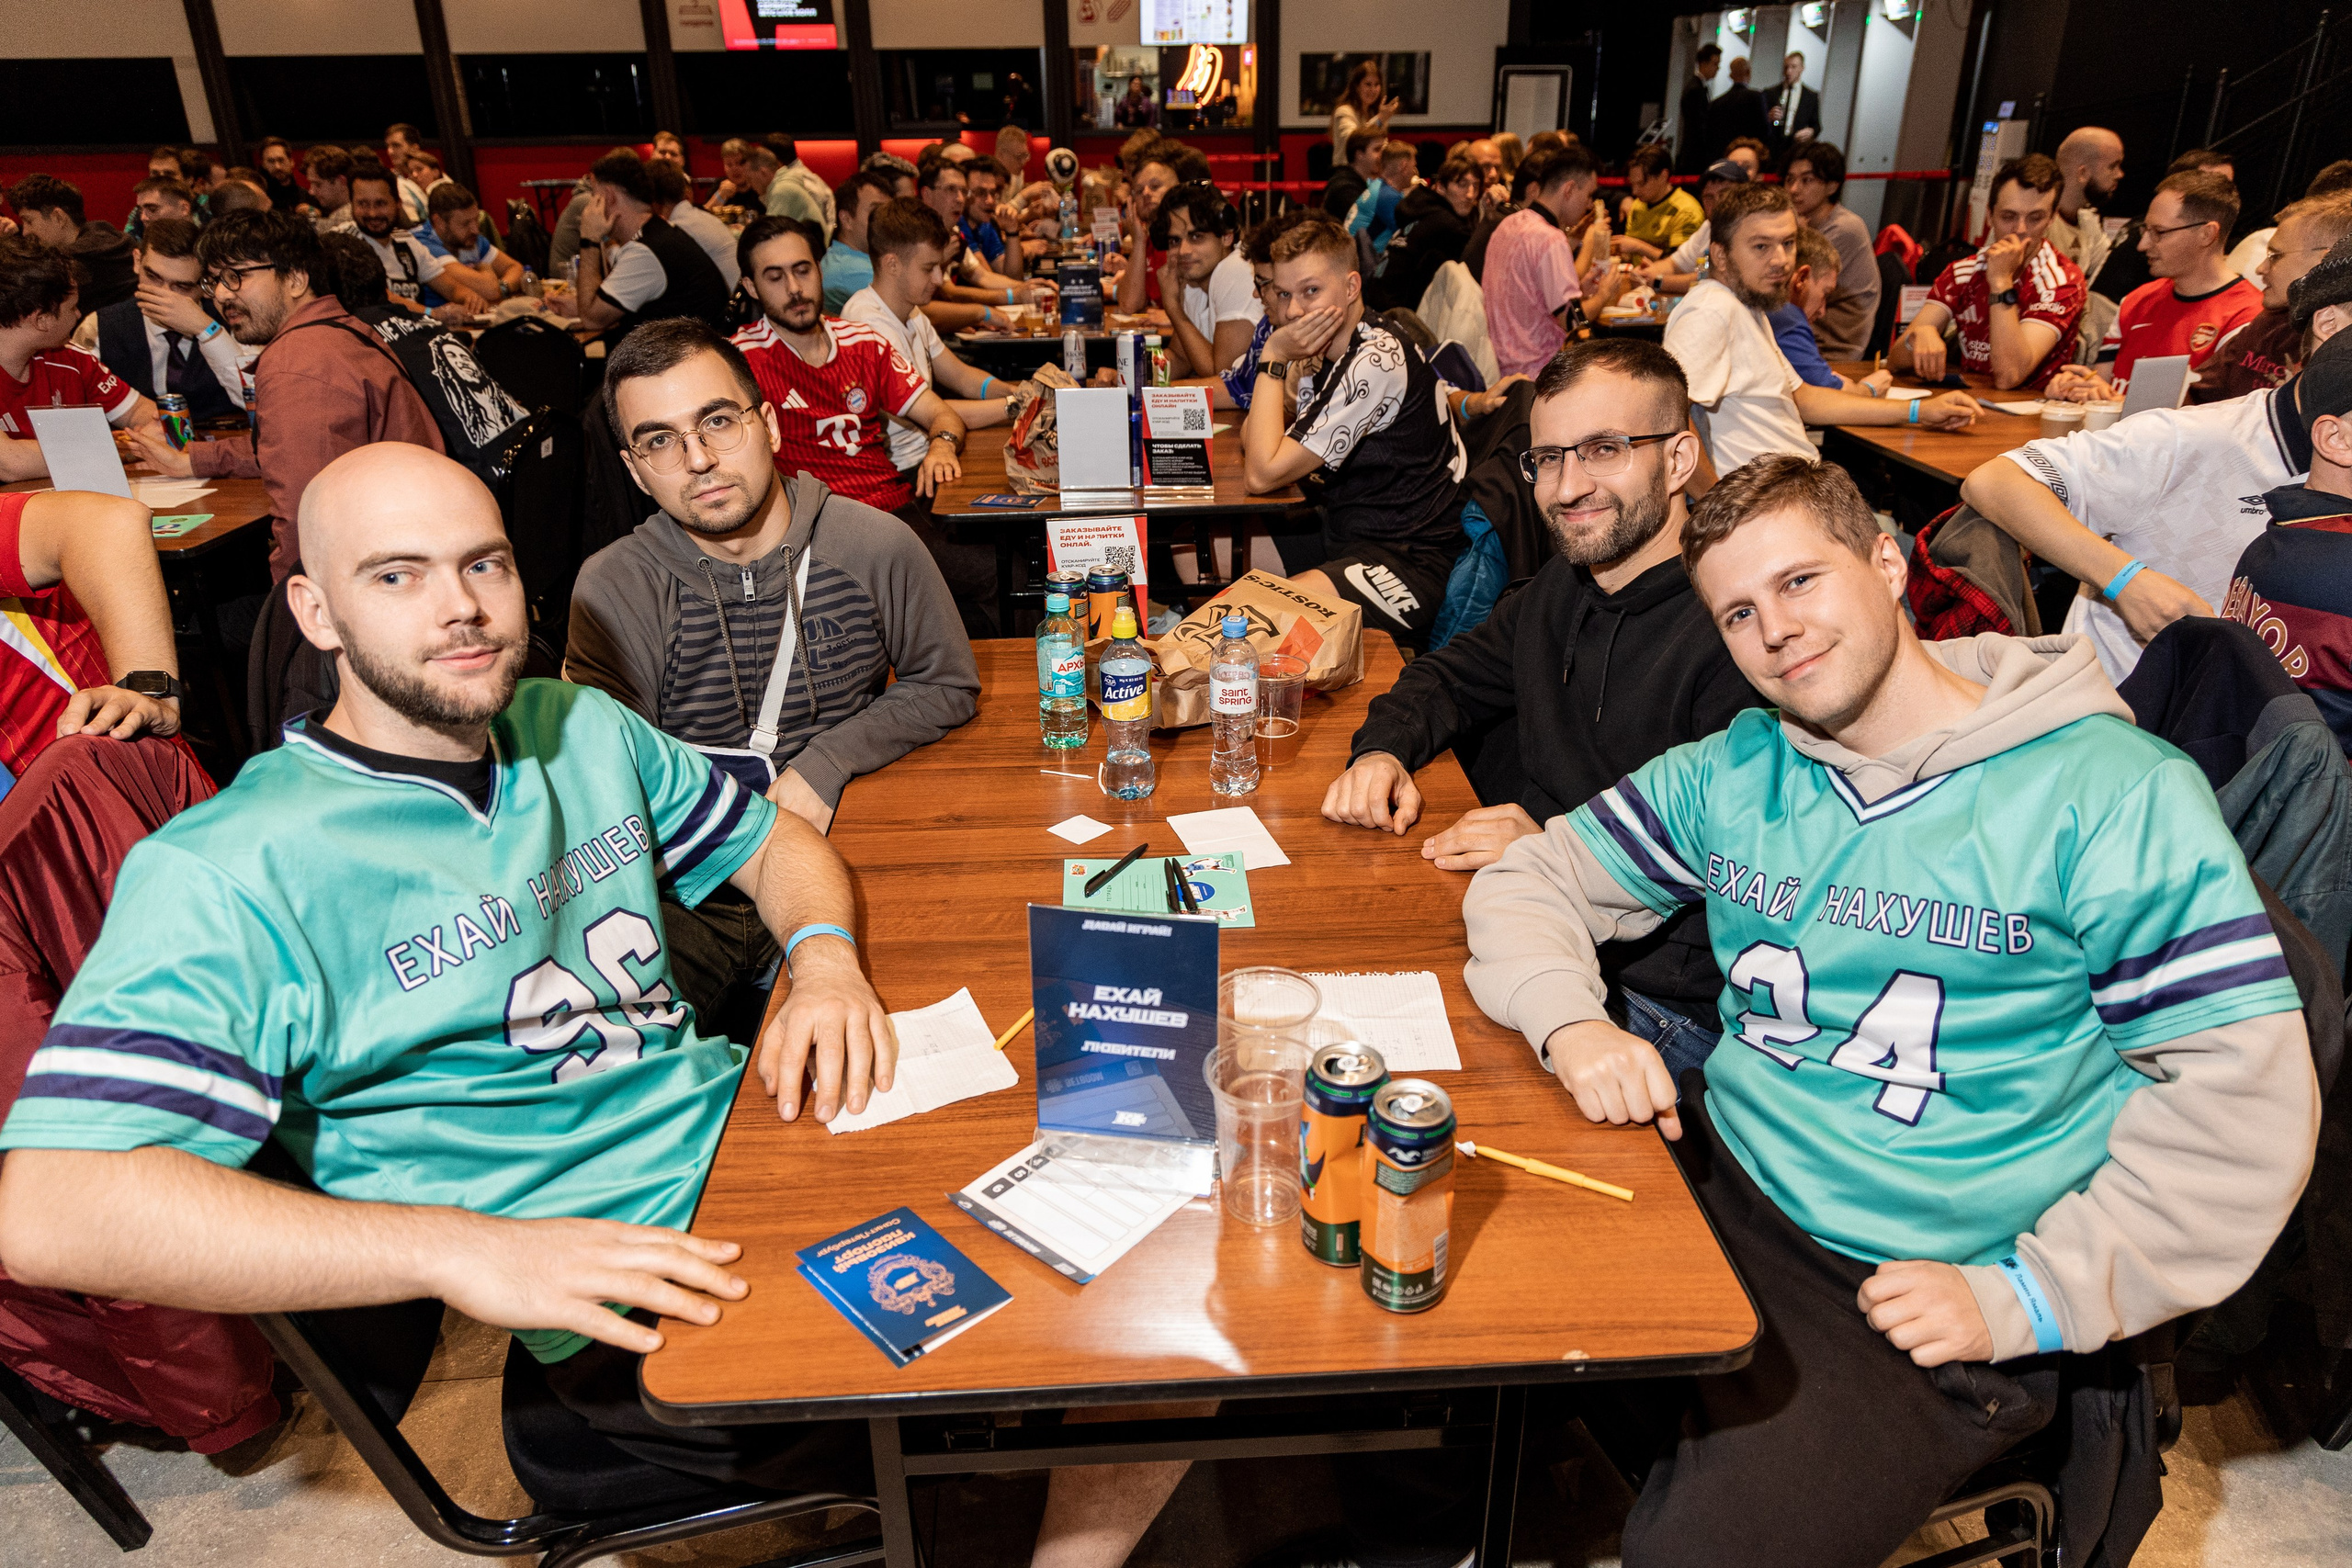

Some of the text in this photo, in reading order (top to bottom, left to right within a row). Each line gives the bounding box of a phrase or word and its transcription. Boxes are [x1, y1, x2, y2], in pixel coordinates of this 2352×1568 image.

[2240, 507, 2264, 515] umbro
[1060, 525, 1122, 534] ЗАКАЗЫВАЙТЕ
[1243, 574, 1337, 619] ROSTIC'S
[1366, 564, 1420, 615] NIKE
[386, 814, 650, 992] ЕХАЙ НАХУШЕВ
[1706, 852, 2035, 955] ЕХАЙ НАХУШЕВ
[1081, 919, 1126, 933] ДАВАЙ
[1093, 985, 1163, 1007] ЕХАЙ
[1068, 1002, 1189, 1028] НАХУШЕВ
[1729, 939, 1946, 1127] 24
[1081, 1040, 1176, 1060] ЛЮБИТЕЛИ
[992, 1183, 1004, 1193] 6
[1013, 1168, 1026, 1179] 5
[817, 1217, 901, 1258] Санкт-Петербург
[832, 1231, 916, 1274] квизовый
[834, 1228, 904, 1265] паспорт
